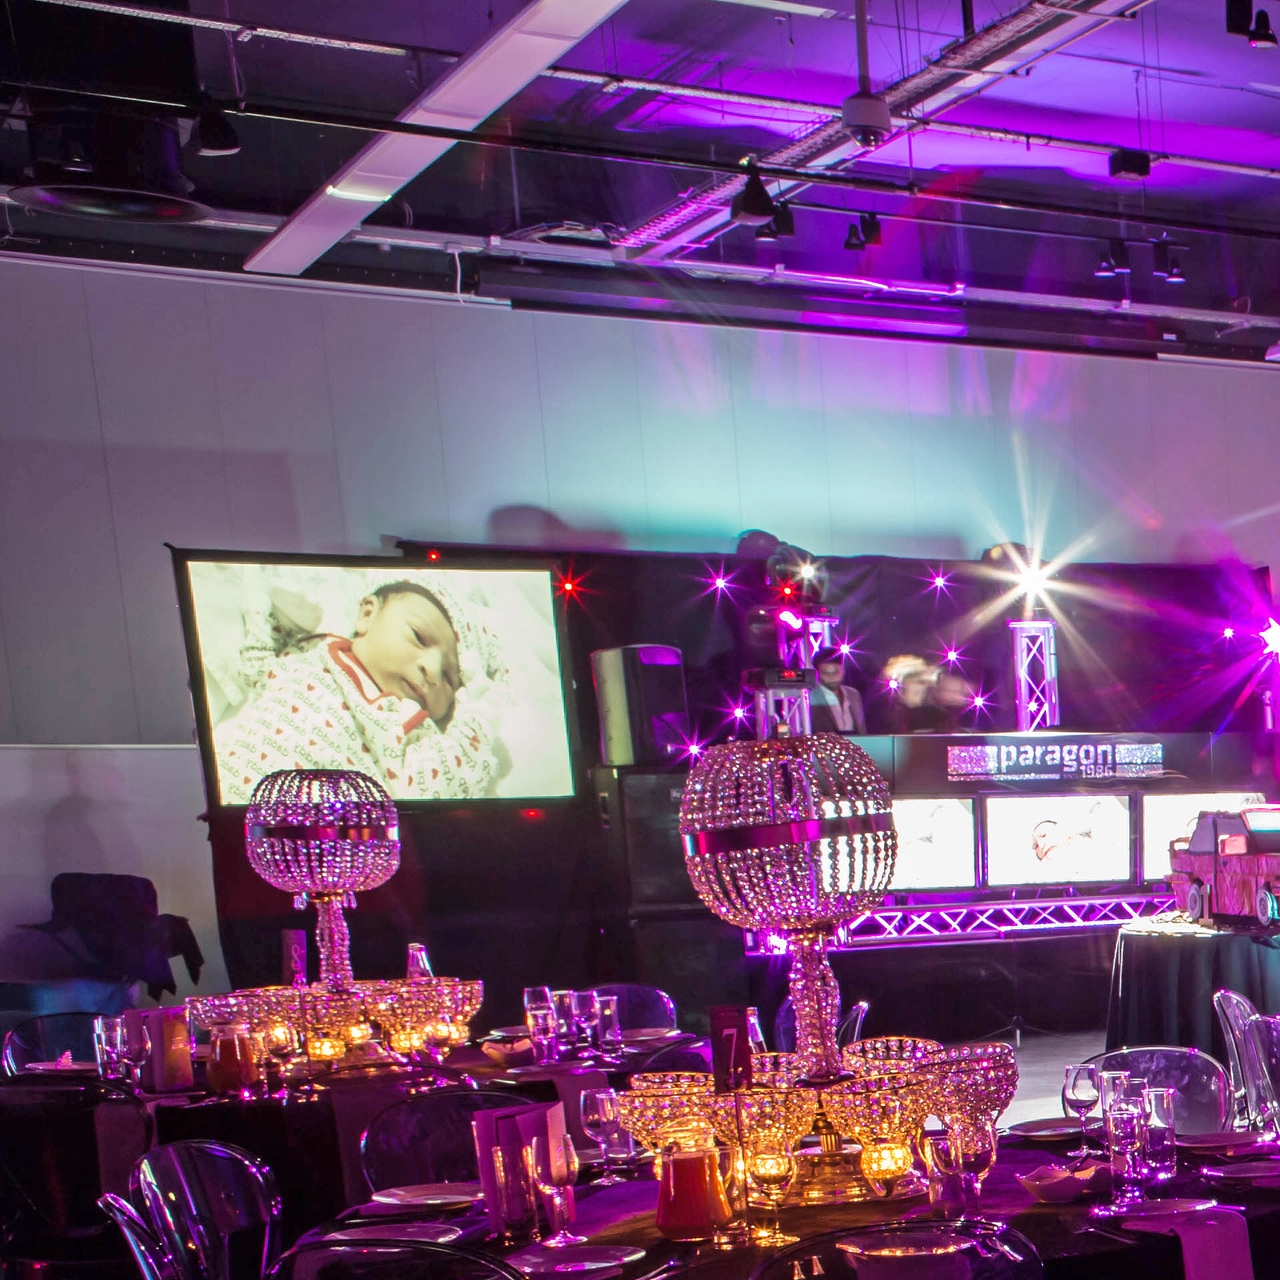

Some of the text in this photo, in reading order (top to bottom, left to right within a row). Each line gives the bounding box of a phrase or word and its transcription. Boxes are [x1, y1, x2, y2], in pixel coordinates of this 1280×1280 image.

[1000, 744, 1113, 773] paragon
[1079, 764, 1113, 779] 1986
[722, 1027, 737, 1071] 7
